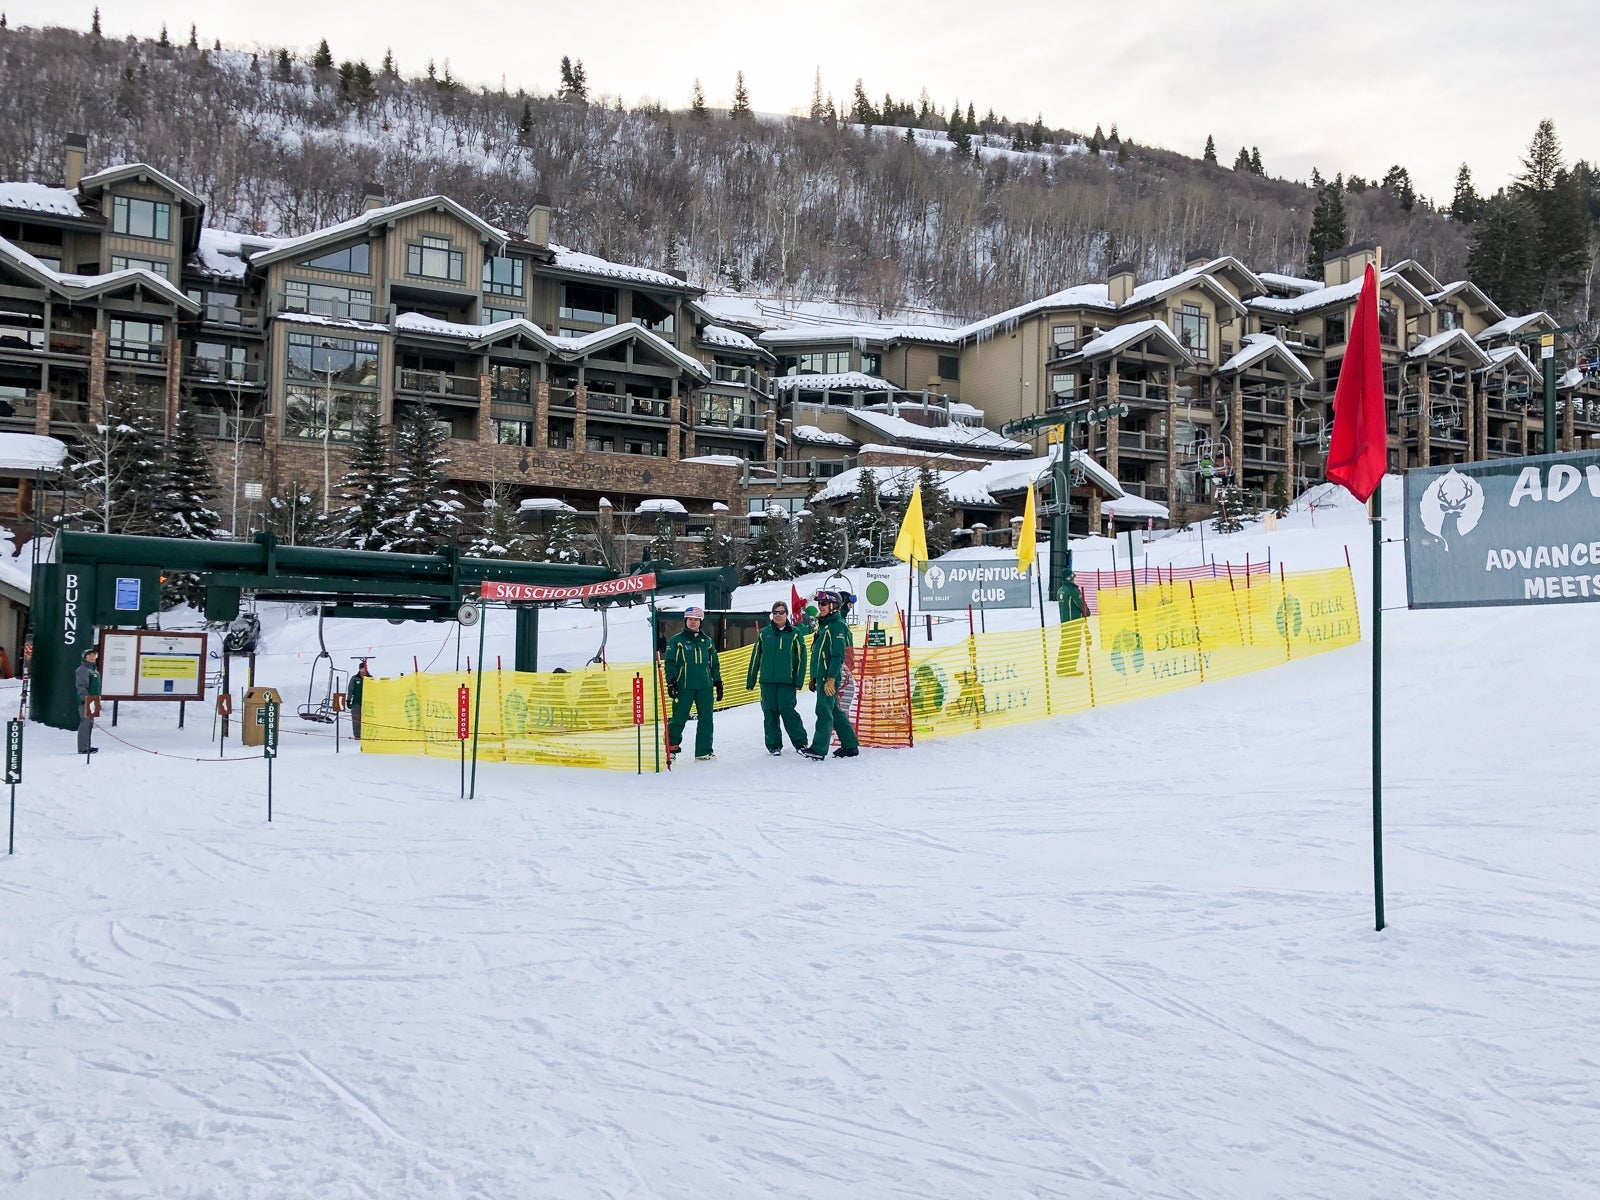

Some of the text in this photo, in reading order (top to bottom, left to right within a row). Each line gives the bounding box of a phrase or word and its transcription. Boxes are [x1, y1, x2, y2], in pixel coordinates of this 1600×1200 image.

[532, 458, 641, 477] BLACK DIAMOND
[866, 571, 890, 580] Beginner
[948, 566, 1027, 583] ADVENTURE
[496, 576, 644, 599] SKI SCHOOL LESSONS
[971, 588, 1006, 603] CLUB
[64, 574, 79, 645] BURNS
[1310, 595, 1346, 618] DEER
[1156, 626, 1203, 652] DEER
[1306, 617, 1356, 644] VALLEY
[1150, 650, 1213, 680] VALLEY
[11, 725, 19, 770] DOUBLES
